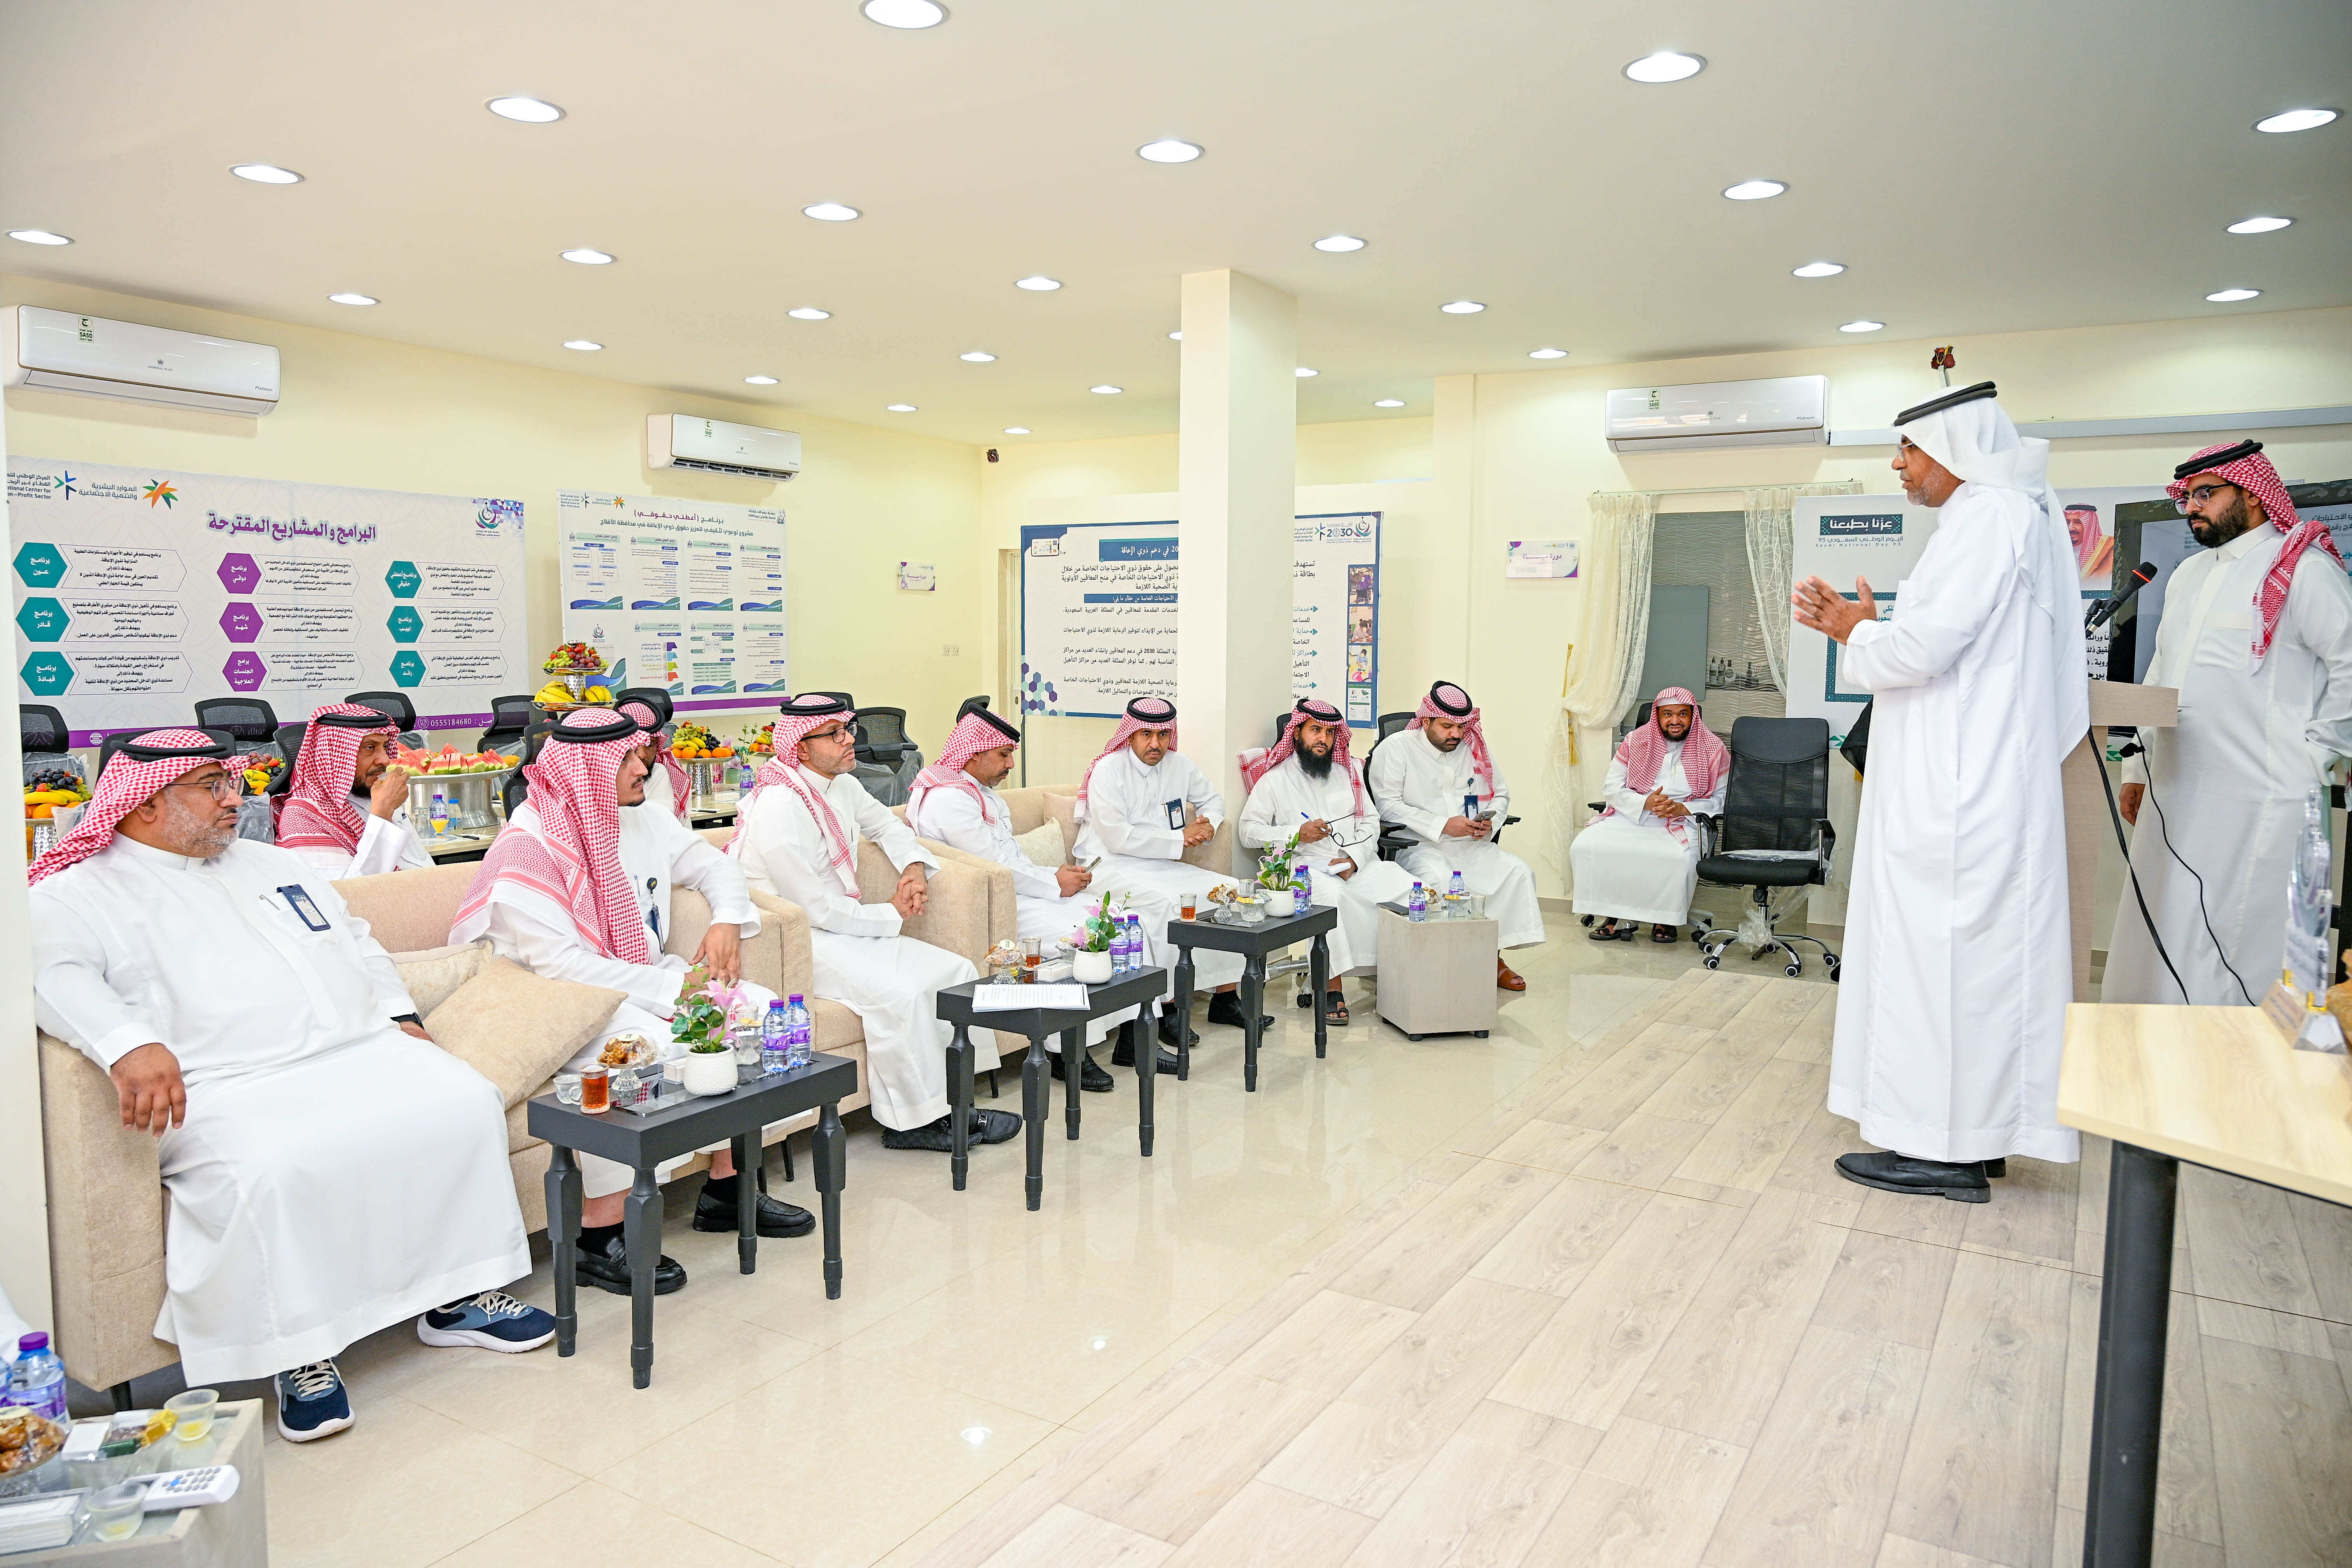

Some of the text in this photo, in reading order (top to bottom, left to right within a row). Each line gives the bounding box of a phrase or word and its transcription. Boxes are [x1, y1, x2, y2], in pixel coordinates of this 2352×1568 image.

[112, 492, 138, 500] والتنمية
[209, 513, 270, 534] المقترحة
[701, 516, 724, 525] برنامج
[1830, 518, 1869, 532] بطبعنا
[647, 522, 662, 530] الإعاقة
[337, 525, 376, 544] البرامج
[1121, 546, 1135, 556] الإعاقة
[1137, 546, 1148, 557] ذوي
[1150, 549, 1161, 558] دعم
[1163, 546, 1169, 557] في
[30, 557, 50, 565] برنامج
[1294, 560, 1315, 569] تستهدف
[1101, 565, 1125, 574] الاحتياجات
[1127, 565, 1137, 574] ذوي
[233, 575, 247, 583] دوائي
[390, 570, 403, 579] أعطني
[1062, 574, 1078, 582] الأولوية
[1110, 574, 1117, 584] في
[1137, 574, 1163, 582] الاحتياجات
[1164, 574, 1175, 582] ذوي
[1300, 570, 1315, 579] بطاقة
[34, 610, 53, 618] برنامج
[1116, 607, 1123, 615] في
[1293, 660, 1309, 668] التأهيل
[36, 665, 56, 673] برنامج
[430, 718, 472, 727] 0555184680
